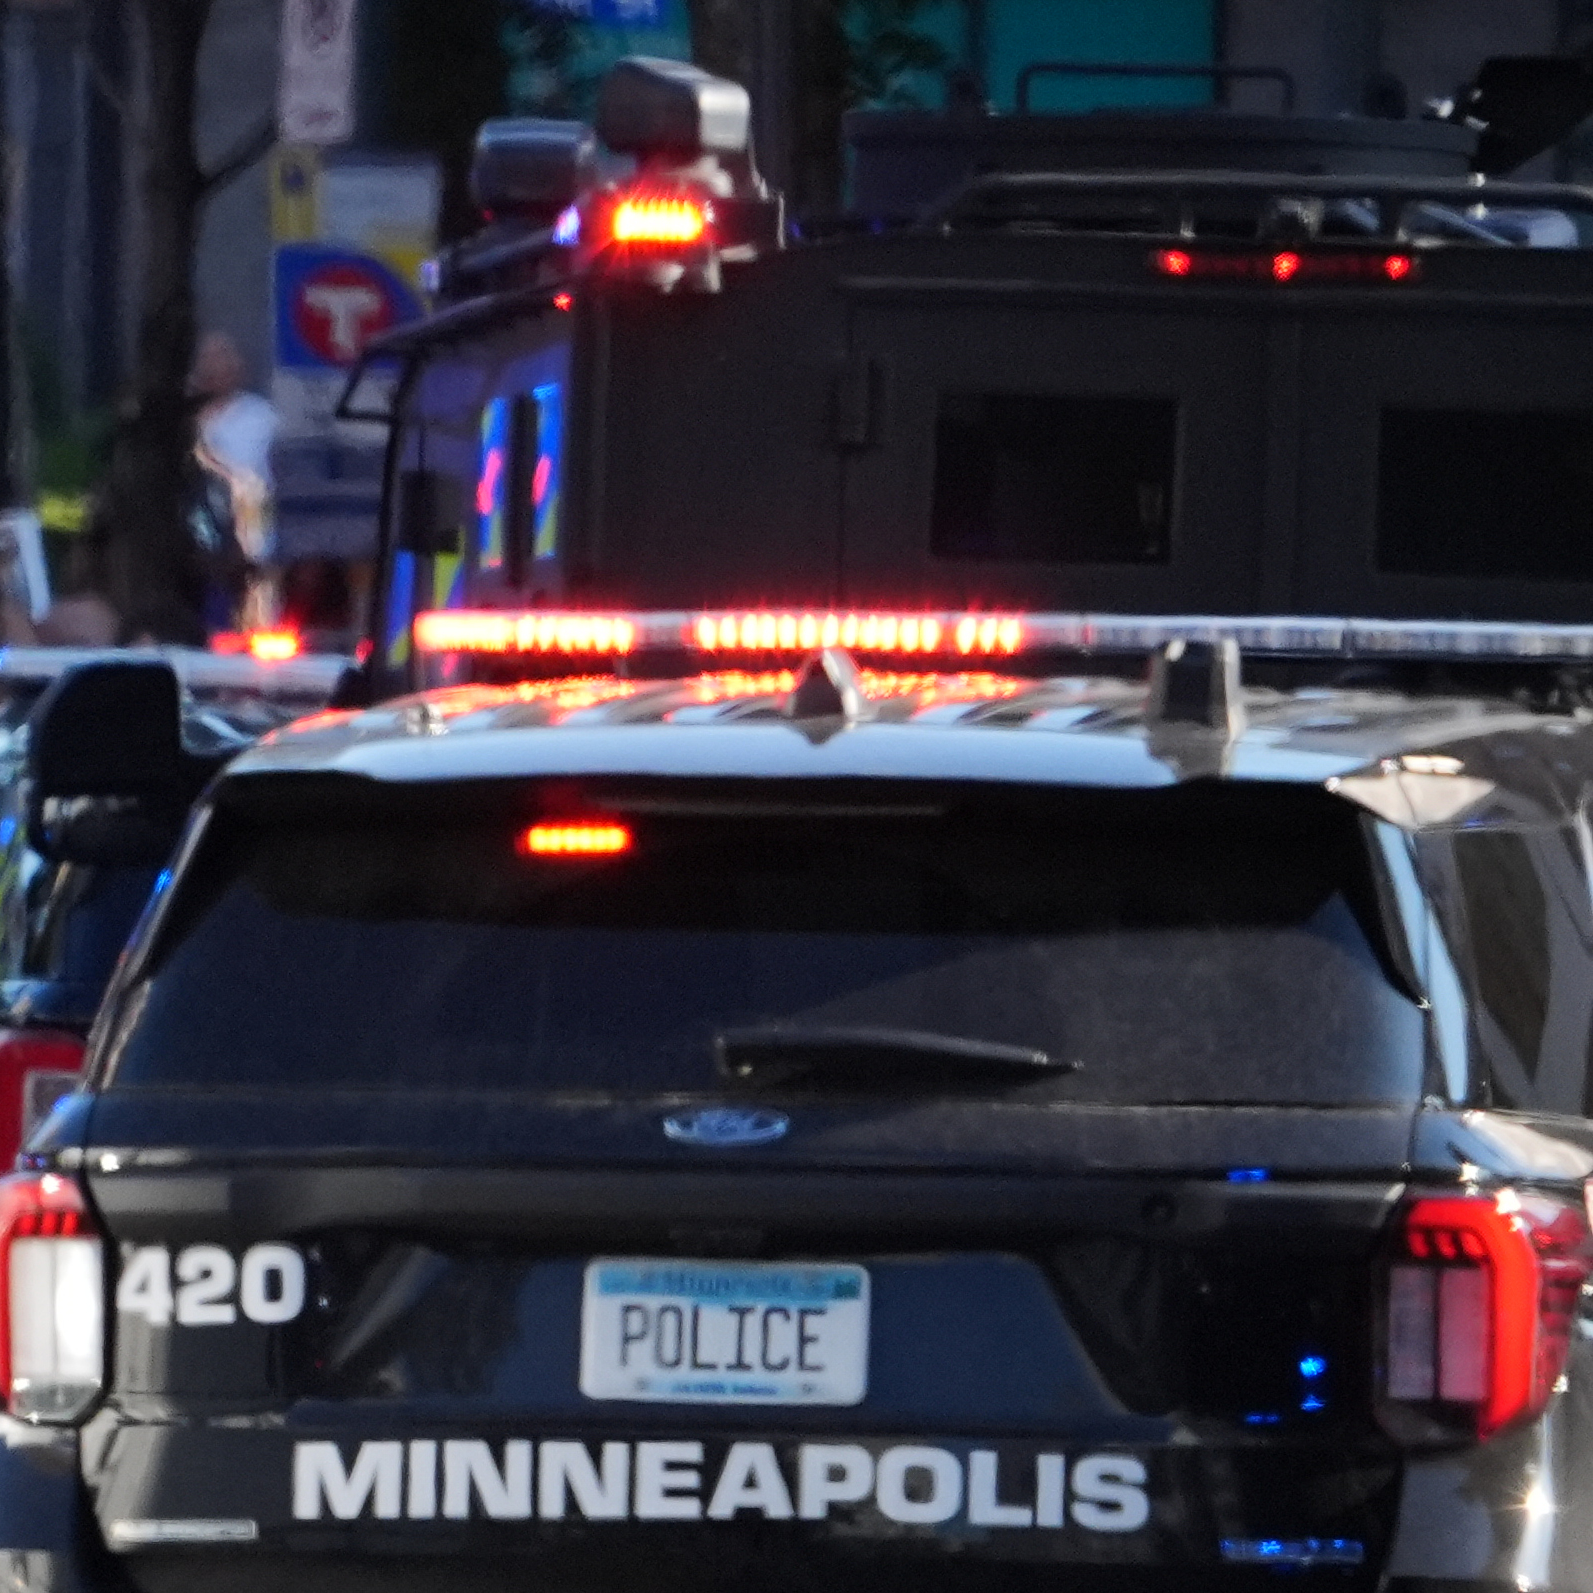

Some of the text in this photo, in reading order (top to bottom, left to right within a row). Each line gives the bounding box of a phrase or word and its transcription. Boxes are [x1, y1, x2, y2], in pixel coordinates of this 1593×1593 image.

[117, 1242, 306, 1327] 420
[618, 1303, 828, 1372] POLICE
[292, 1439, 1151, 1533] MINNEAPOLIS
